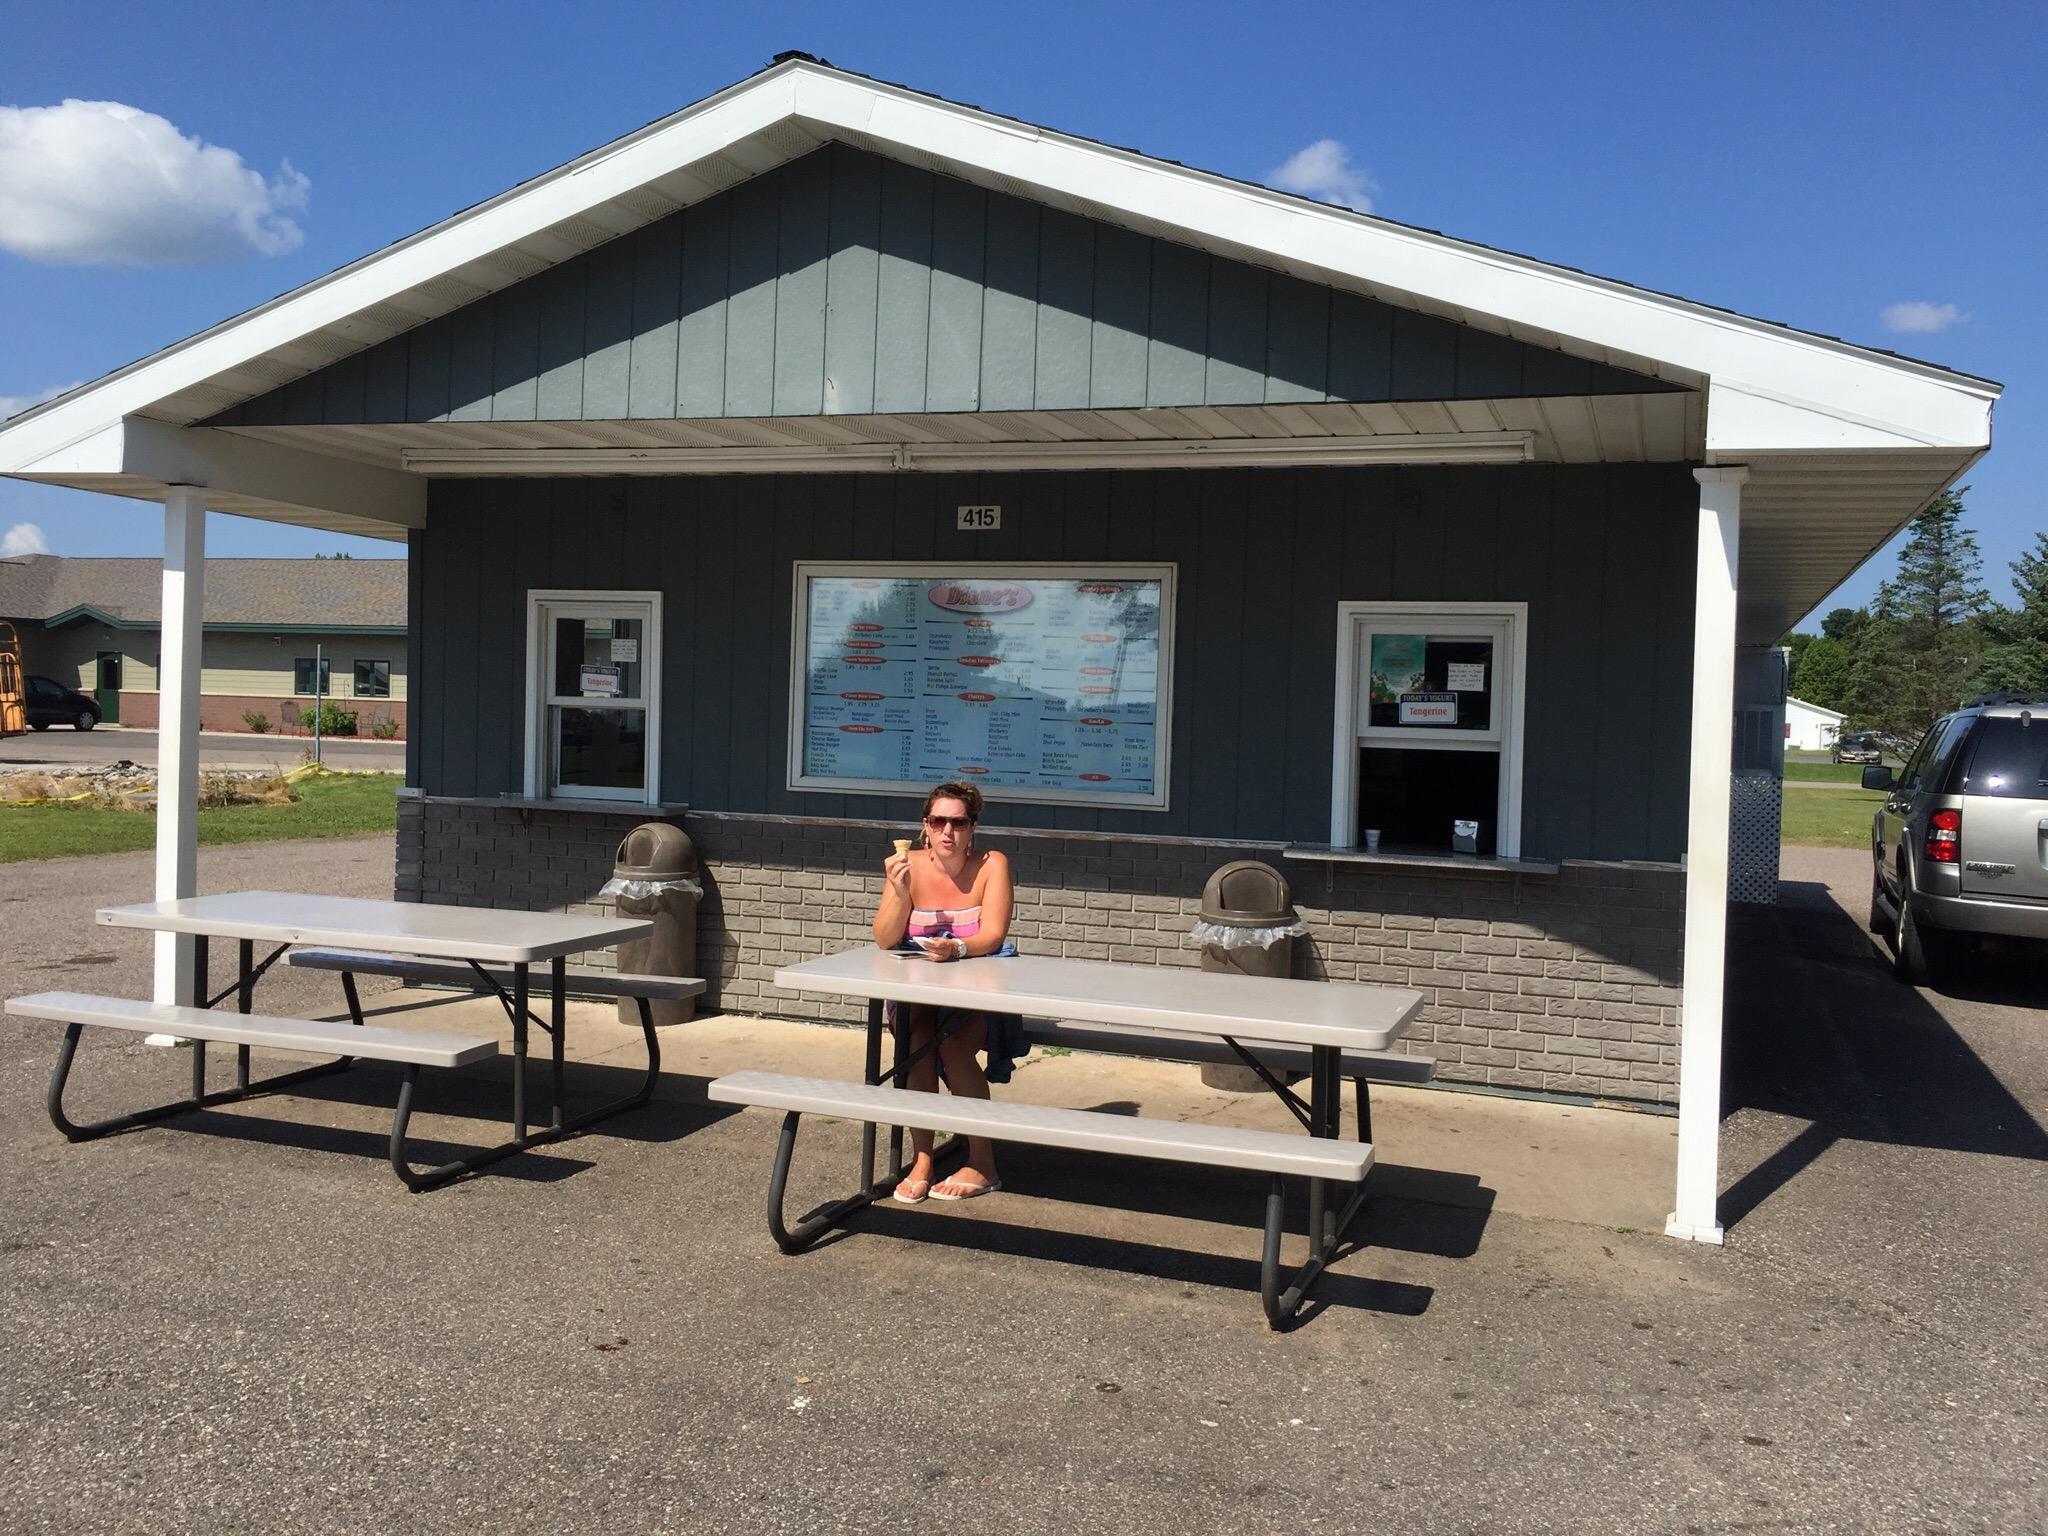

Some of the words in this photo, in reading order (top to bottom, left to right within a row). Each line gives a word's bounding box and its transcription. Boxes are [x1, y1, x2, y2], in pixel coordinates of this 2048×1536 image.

[963, 508, 995, 526] 415
[1404, 694, 1428, 702] TODAY'S
[1429, 694, 1454, 702] YOGURT
[1409, 706, 1448, 717] Tangerine
